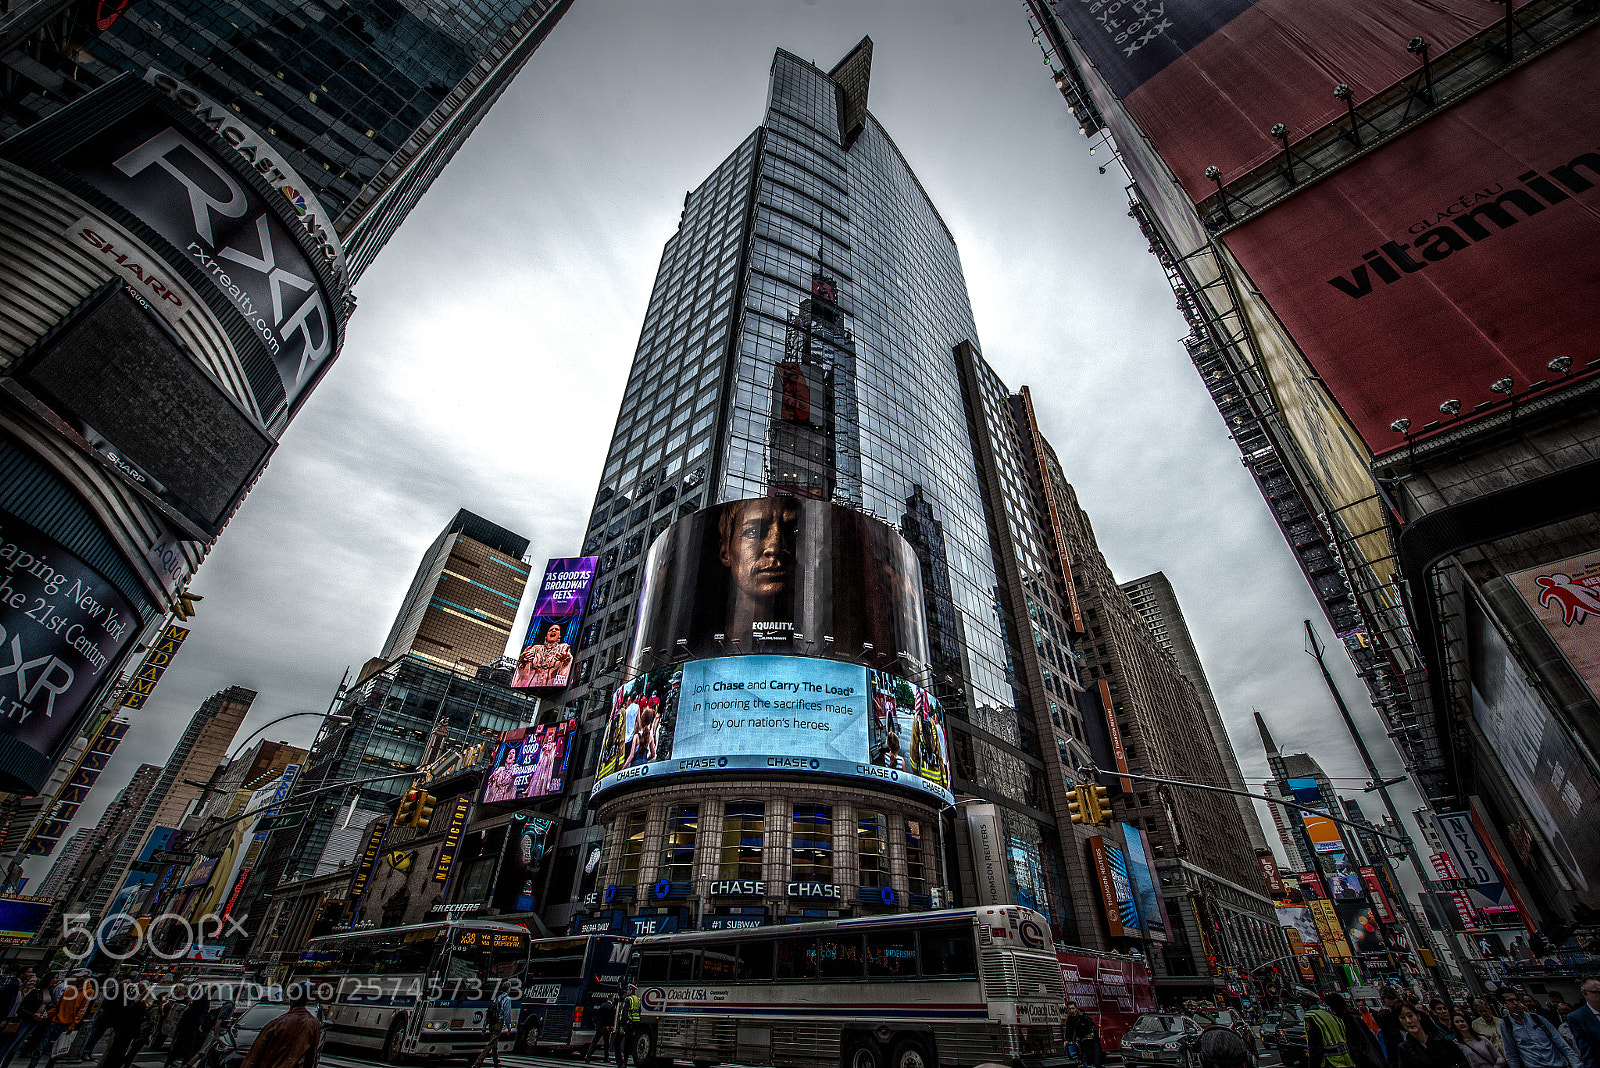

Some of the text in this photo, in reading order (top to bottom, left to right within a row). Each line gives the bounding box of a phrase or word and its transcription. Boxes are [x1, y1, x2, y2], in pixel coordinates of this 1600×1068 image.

[1103, 18, 1126, 34] it.
[1114, 2, 1164, 45] sexy
[1122, 18, 1174, 58] xxx
[154, 72, 288, 191] COMCAST
[1408, 181, 1504, 235] GLACÉAU
[77, 227, 184, 311] SHARP
[112, 125, 331, 388] RXR
[125, 284, 151, 311] AQUOS
[187, 241, 281, 356] rxrrealty.com
[106, 451, 147, 484] SHARP
[153, 541, 185, 588] AQUOS
[557, 571, 579, 580] GOOD
[544, 580, 589, 590] BROADWAY
[64, 577, 106, 622] New
[100, 608, 126, 644] York
[24, 597, 69, 635] 21st
[65, 623, 109, 676] Century
[125, 625, 189, 709] MADAME
[692, 683, 710, 696] Join
[713, 680, 745, 692] Chase
[747, 680, 767, 690] and
[769, 680, 800, 693] Carry
[802, 681, 823, 693] The
[692, 698, 853, 715] in honoring the sacrifices made
[711, 718, 724, 731] by
[727, 719, 745, 729] our
[793, 718, 832, 732] heroes.
[522, 743, 539, 754] GOOD
[523, 754, 532, 764] AS
[32, 722, 126, 855] TUSSAUDS
[616, 766, 641, 782] CHASE
[679, 757, 717, 770] CHASE
[766, 756, 808, 768] CHASE
[856, 765, 890, 779] CHASE
[922, 780, 942, 795] CHASE
[270, 820, 276, 829] 7
[436, 797, 469, 880] NEW VICTORY
[352, 824, 385, 895] NEW VICTORY
[979, 824, 998, 905] THOMSON REUTERS
[1447, 818, 1490, 883] NYPD
[710, 880, 841, 899] CHASE CHASE
[1095, 848, 1113, 907] THOMSON REUTERS
[1443, 880, 1453, 890] W
[1456, 879, 1468, 890] 42
[430, 903, 481, 913] SKECHERS
[711, 920, 760, 929] #1 SUBWAY
[634, 921, 657, 934] THE
[667, 988, 707, 1000] Coach USA
[1029, 1004, 1048, 1016] Coach
